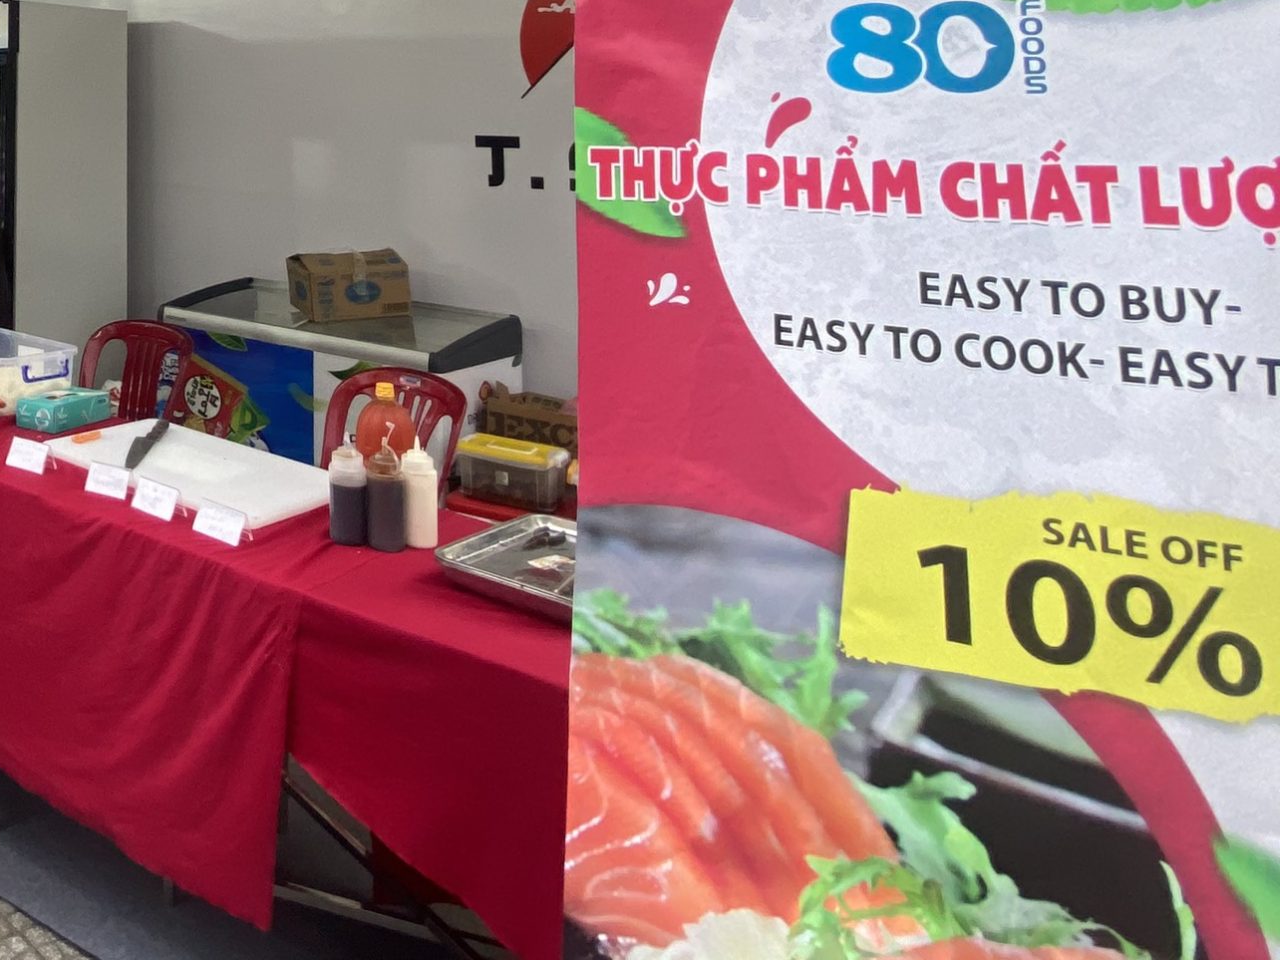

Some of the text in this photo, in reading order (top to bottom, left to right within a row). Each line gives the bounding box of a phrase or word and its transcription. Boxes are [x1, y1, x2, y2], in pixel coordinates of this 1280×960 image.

[826, 0, 1015, 94] 80
[588, 139, 729, 216] THỰC
[745, 135, 923, 217] PHẨM
[938, 140, 1120, 226] CHẤT
[918, 270, 1243, 327] EASY TO BUY-
[773, 313, 874, 356] EASY
[883, 325, 942, 364] TO
[954, 333, 1106, 380] COOK-
[1118, 346, 1246, 393] EASY
[1041, 517, 1244, 573] SALE OFF
[915, 544, 1264, 698] 10%
